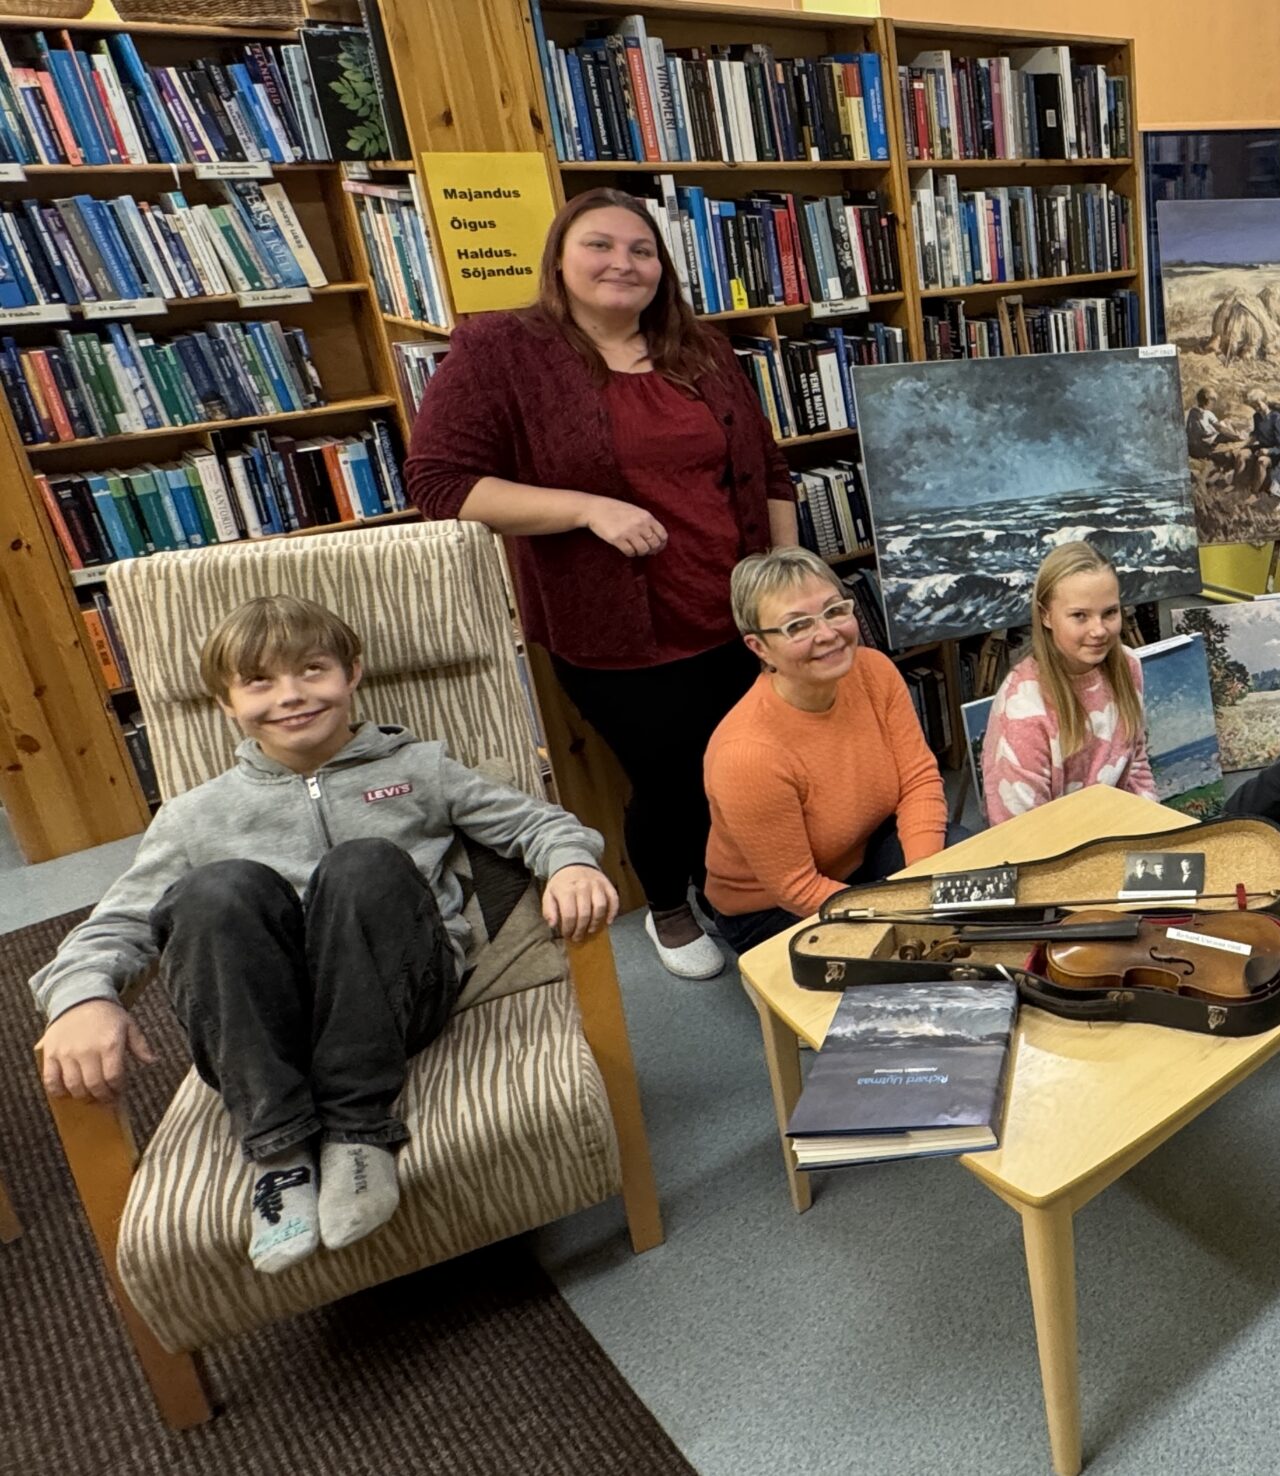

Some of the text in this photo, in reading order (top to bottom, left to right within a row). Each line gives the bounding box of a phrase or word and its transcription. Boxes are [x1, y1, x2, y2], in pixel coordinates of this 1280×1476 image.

[443, 187, 521, 203] Majandus
[450, 216, 496, 231] Õigus
[838, 214, 854, 267] CAPONE
[457, 247, 517, 260] Haldus.
[461, 264, 533, 280] Sõjandus
[800, 372, 810, 398] EESTI
[808, 372, 826, 426] VENE MAFFIA
[366, 784, 412, 801] LEVI'S
[906, 1074, 949, 1085] Richard
